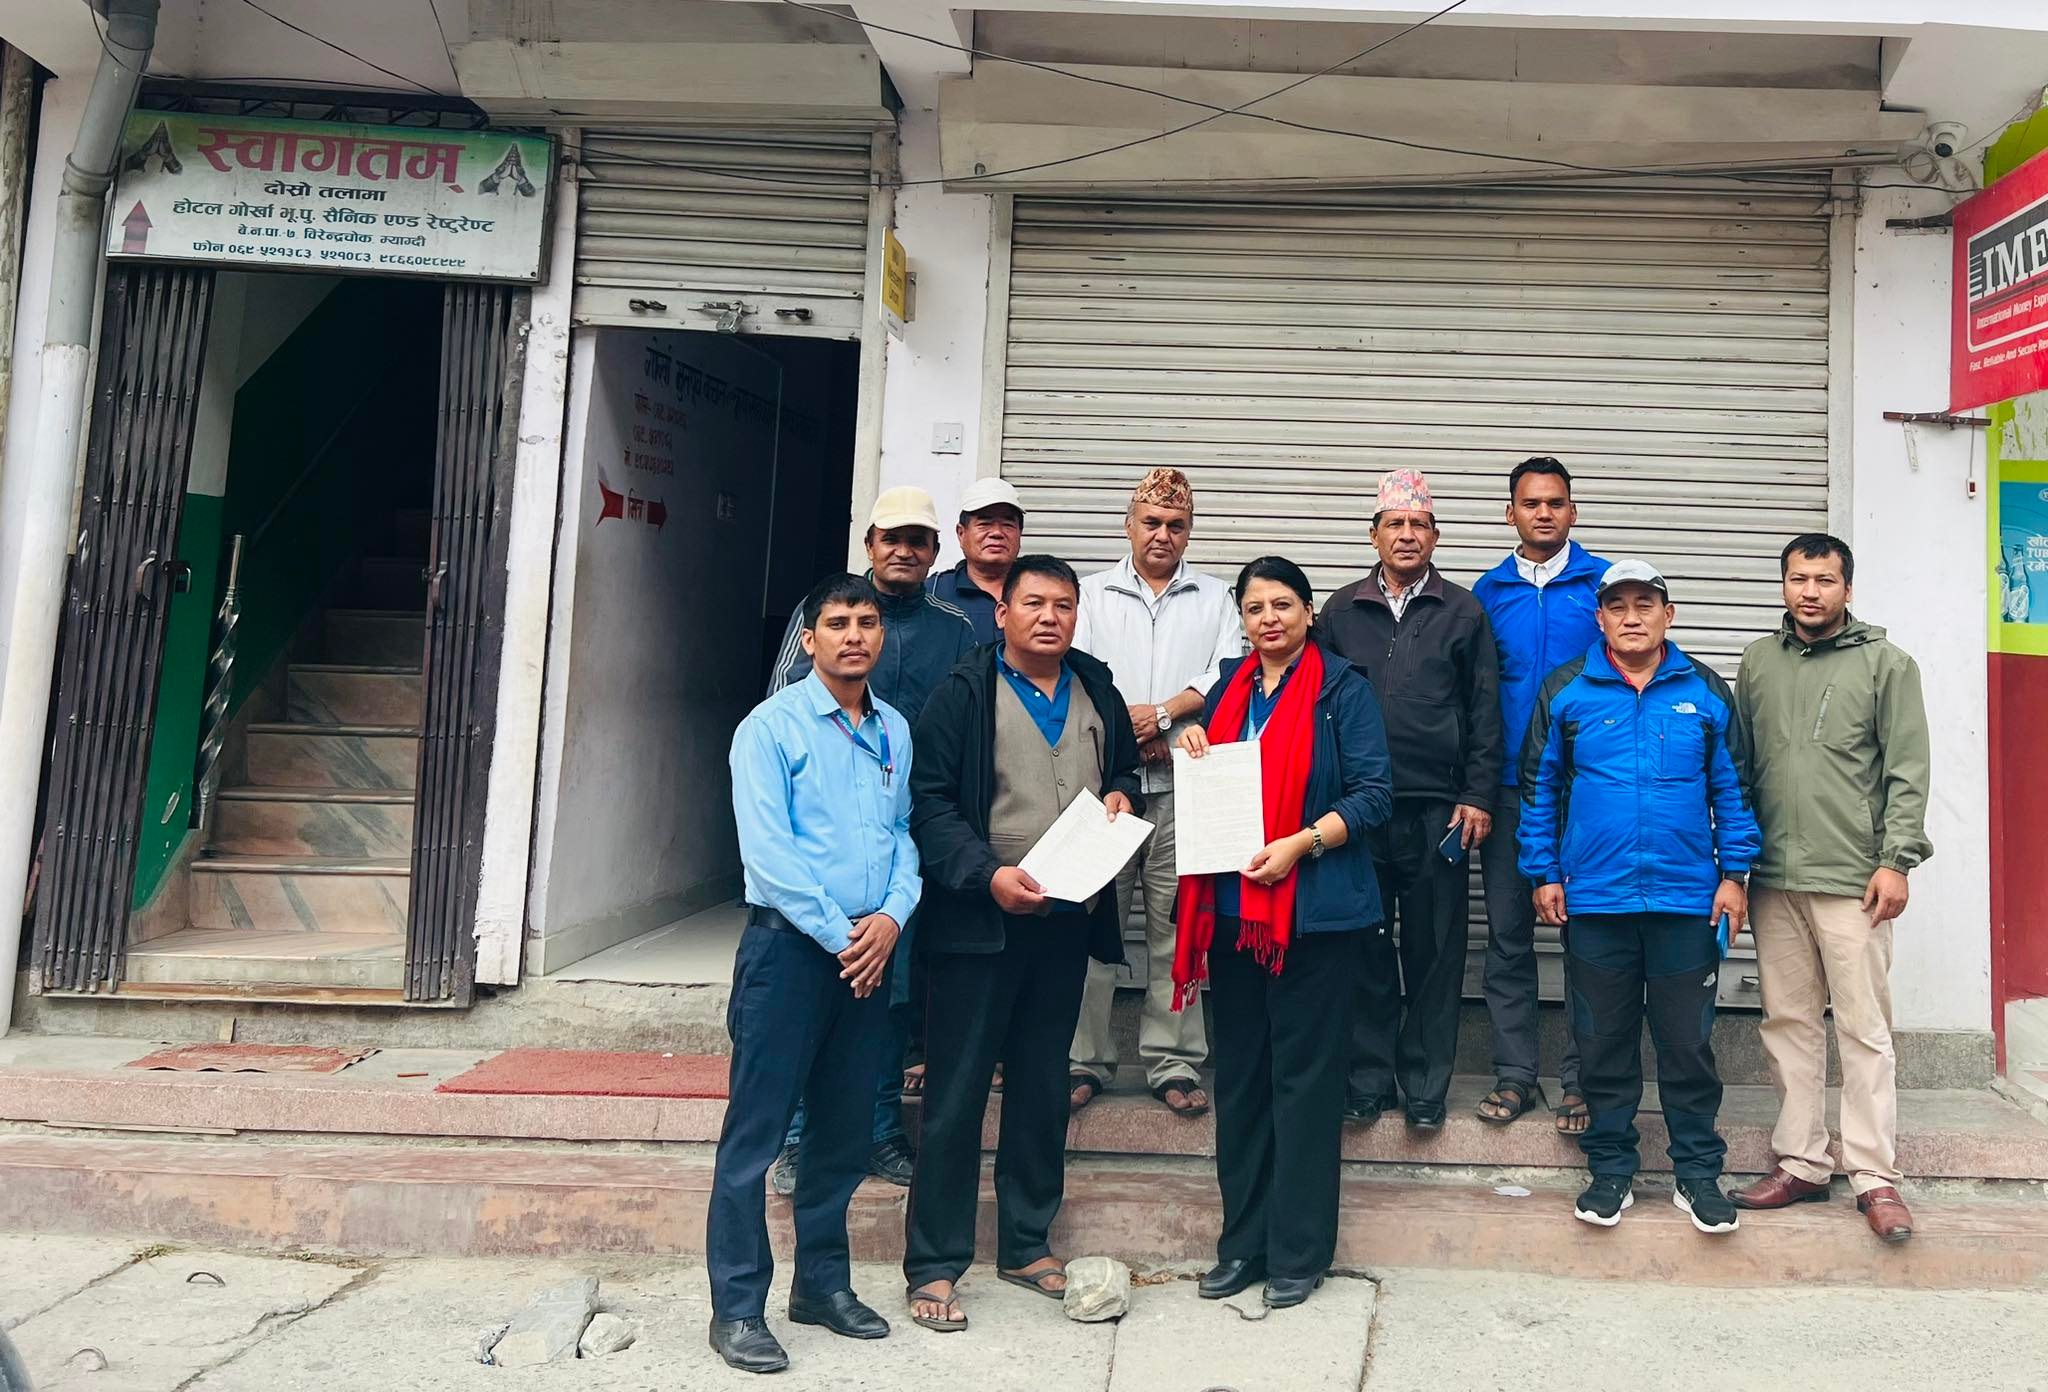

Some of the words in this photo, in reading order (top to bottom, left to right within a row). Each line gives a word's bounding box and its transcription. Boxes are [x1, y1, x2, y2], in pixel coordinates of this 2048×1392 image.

[197, 127, 466, 193] स्वागतम्
[318, 186, 388, 202] तलामा
[172, 198, 224, 215] होटल
[228, 201, 275, 218] गोर्खा
[322, 207, 379, 224] सैनिक
[383, 214, 422, 228] एण्ड
[192, 240, 225, 252] फोन
[379, 235, 426, 247] म्याग्दी
[1982, 217, 2048, 299] IME
